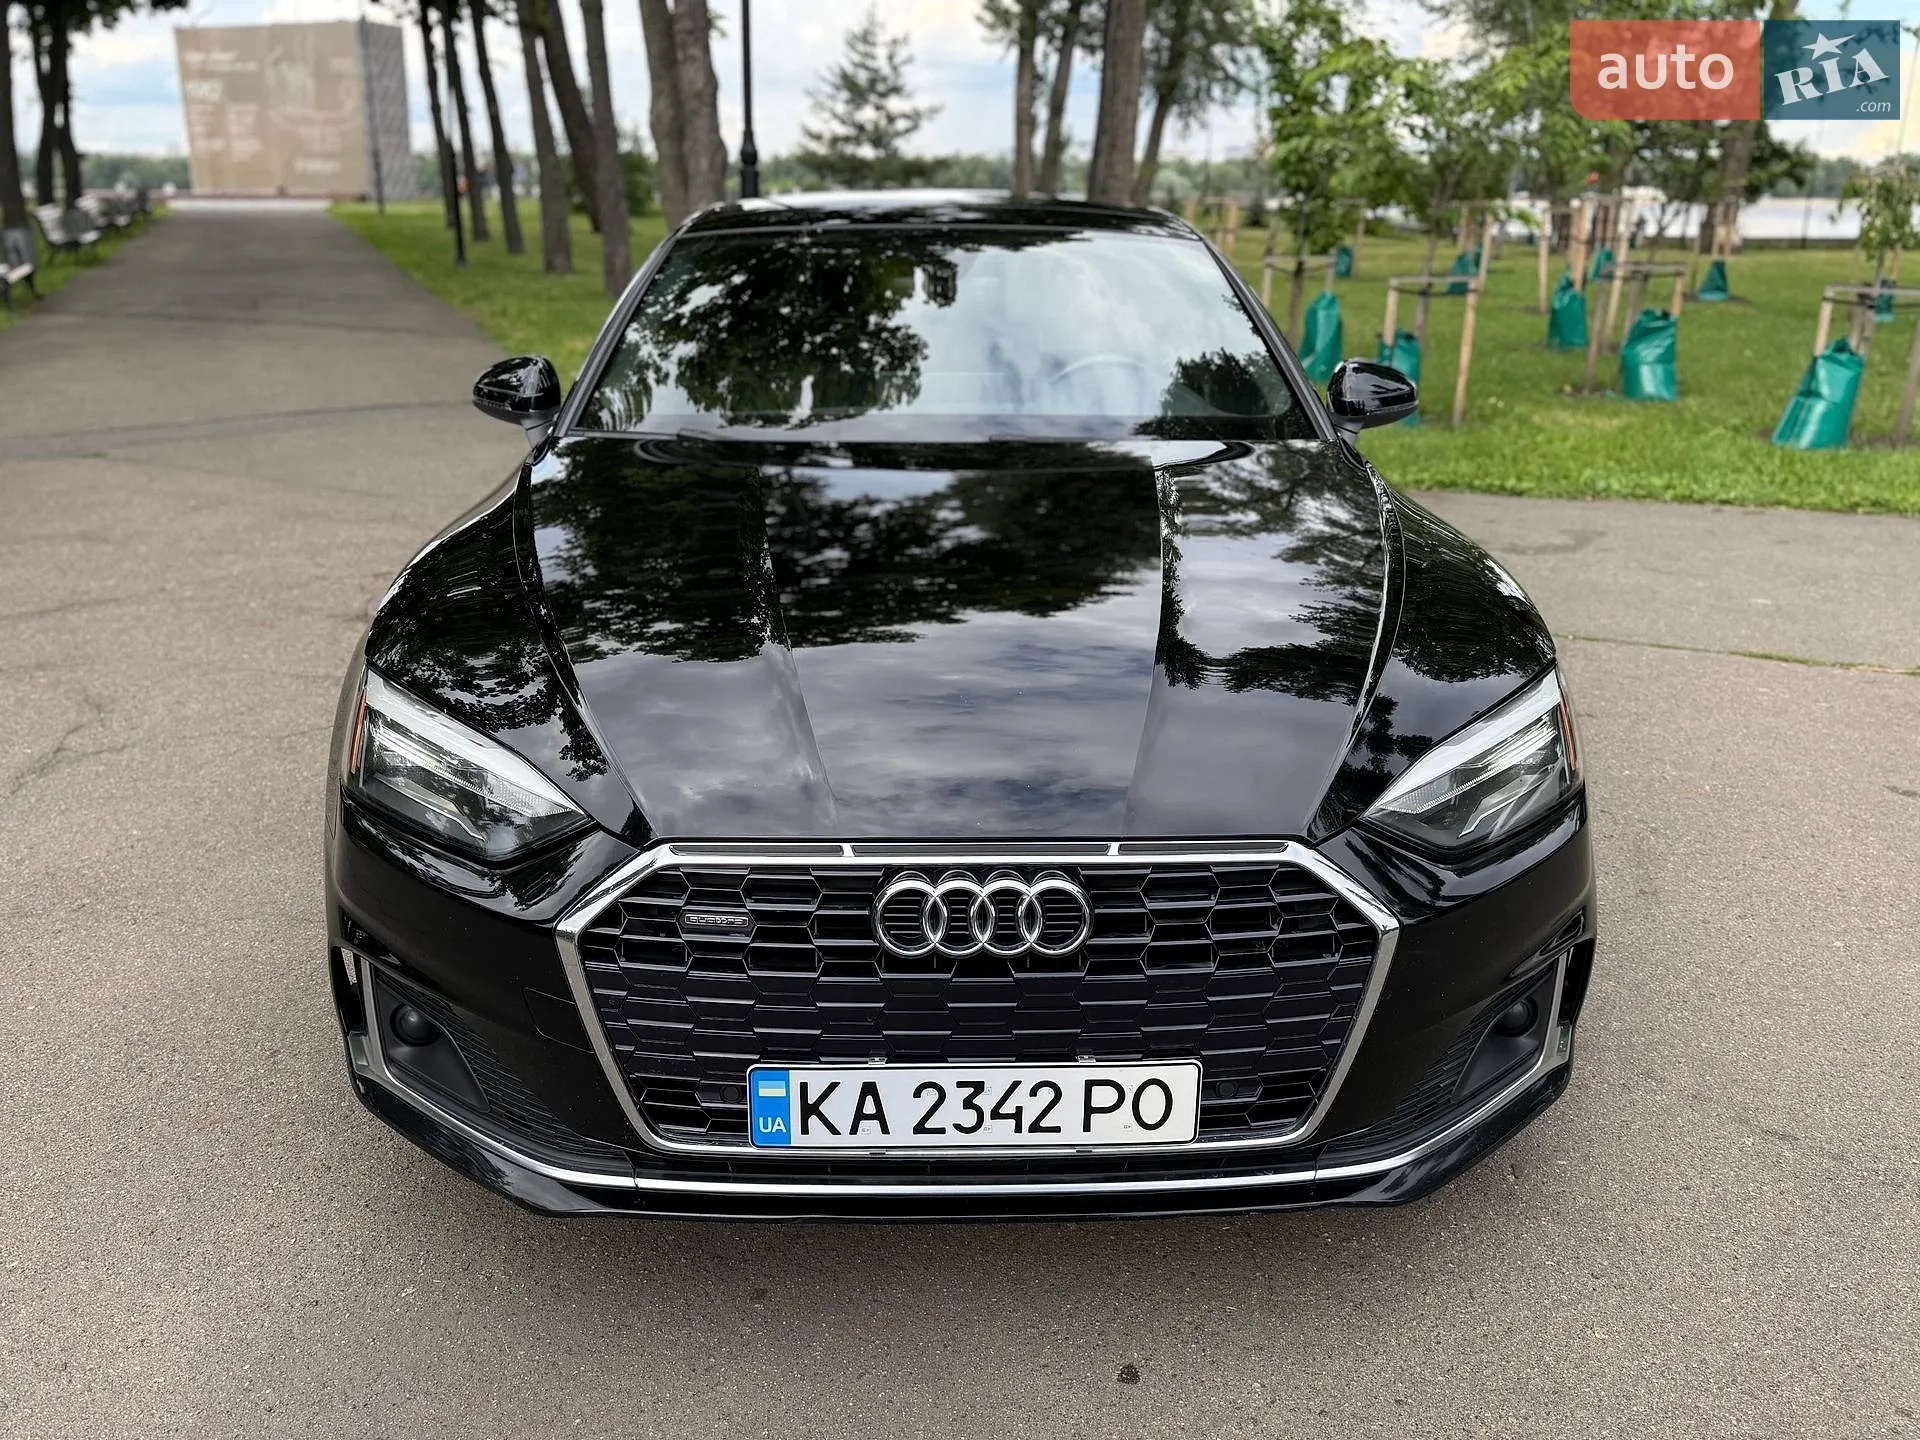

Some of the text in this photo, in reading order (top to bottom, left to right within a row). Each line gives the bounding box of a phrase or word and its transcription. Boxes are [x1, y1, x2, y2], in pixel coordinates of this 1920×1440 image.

[759, 1116, 787, 1133] UA
[799, 1078, 1174, 1136] KA 2342 PO
